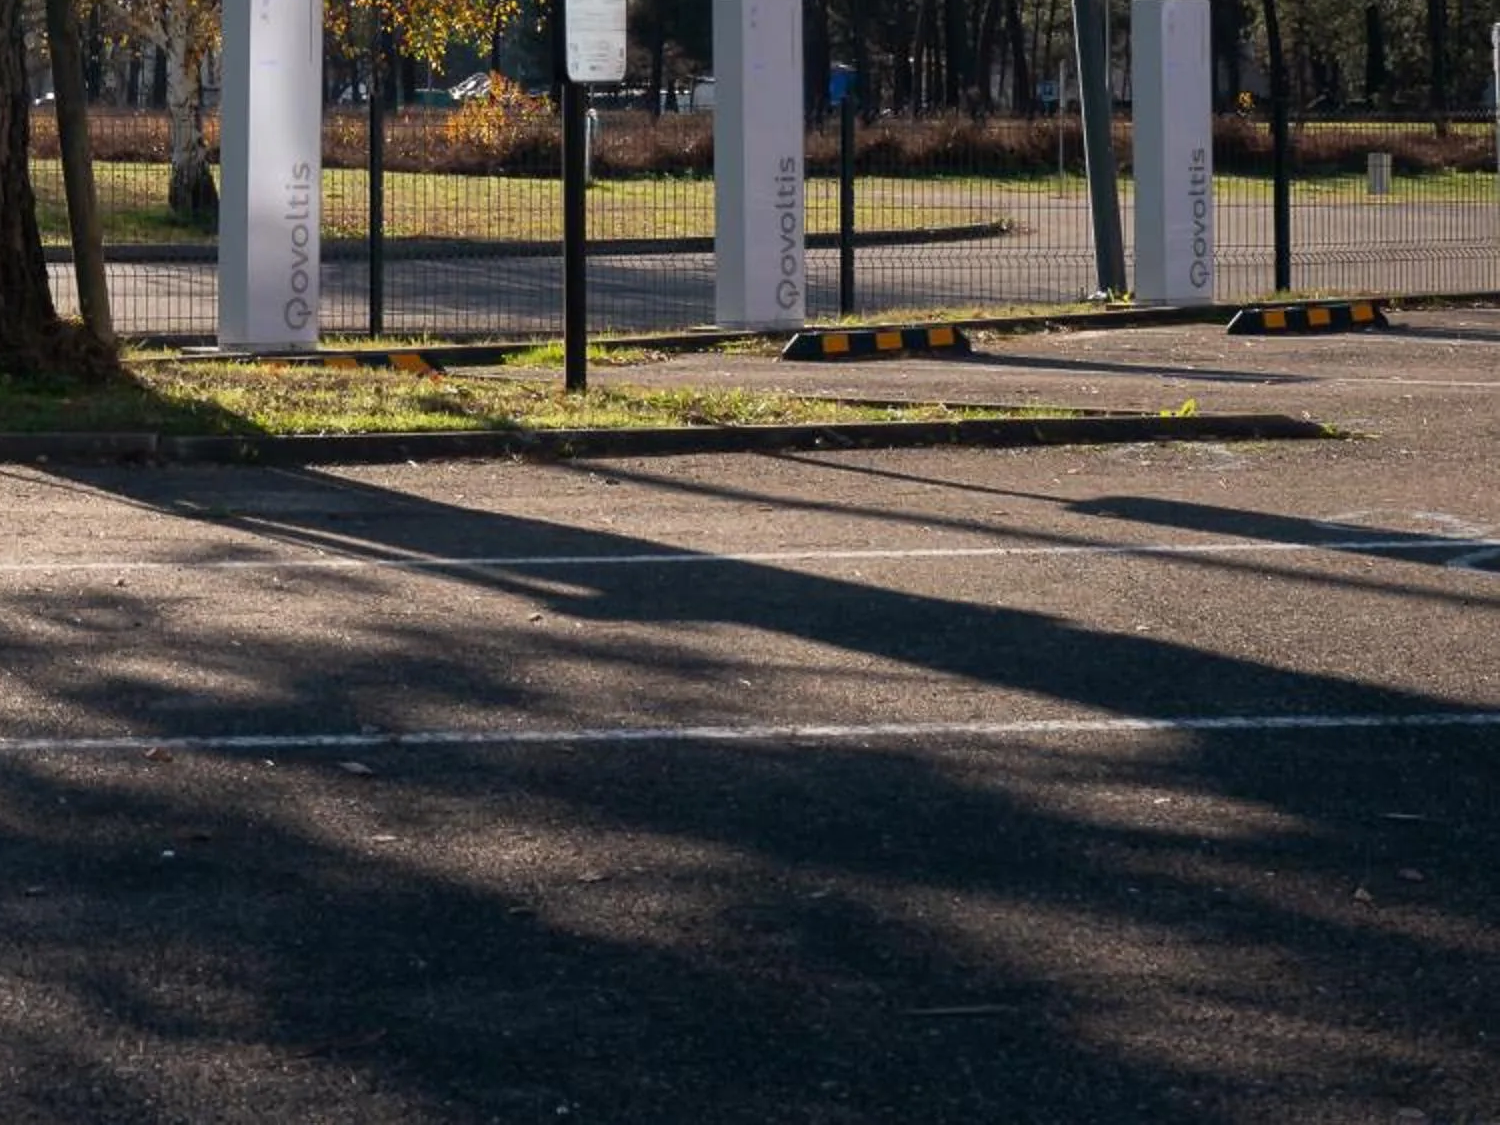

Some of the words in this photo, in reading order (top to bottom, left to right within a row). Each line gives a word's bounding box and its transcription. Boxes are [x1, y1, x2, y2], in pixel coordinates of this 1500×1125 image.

[284, 162, 312, 330] Qovoltis
[775, 156, 800, 310] Qovoltis
[1188, 148, 1210, 289] Qovoltis
